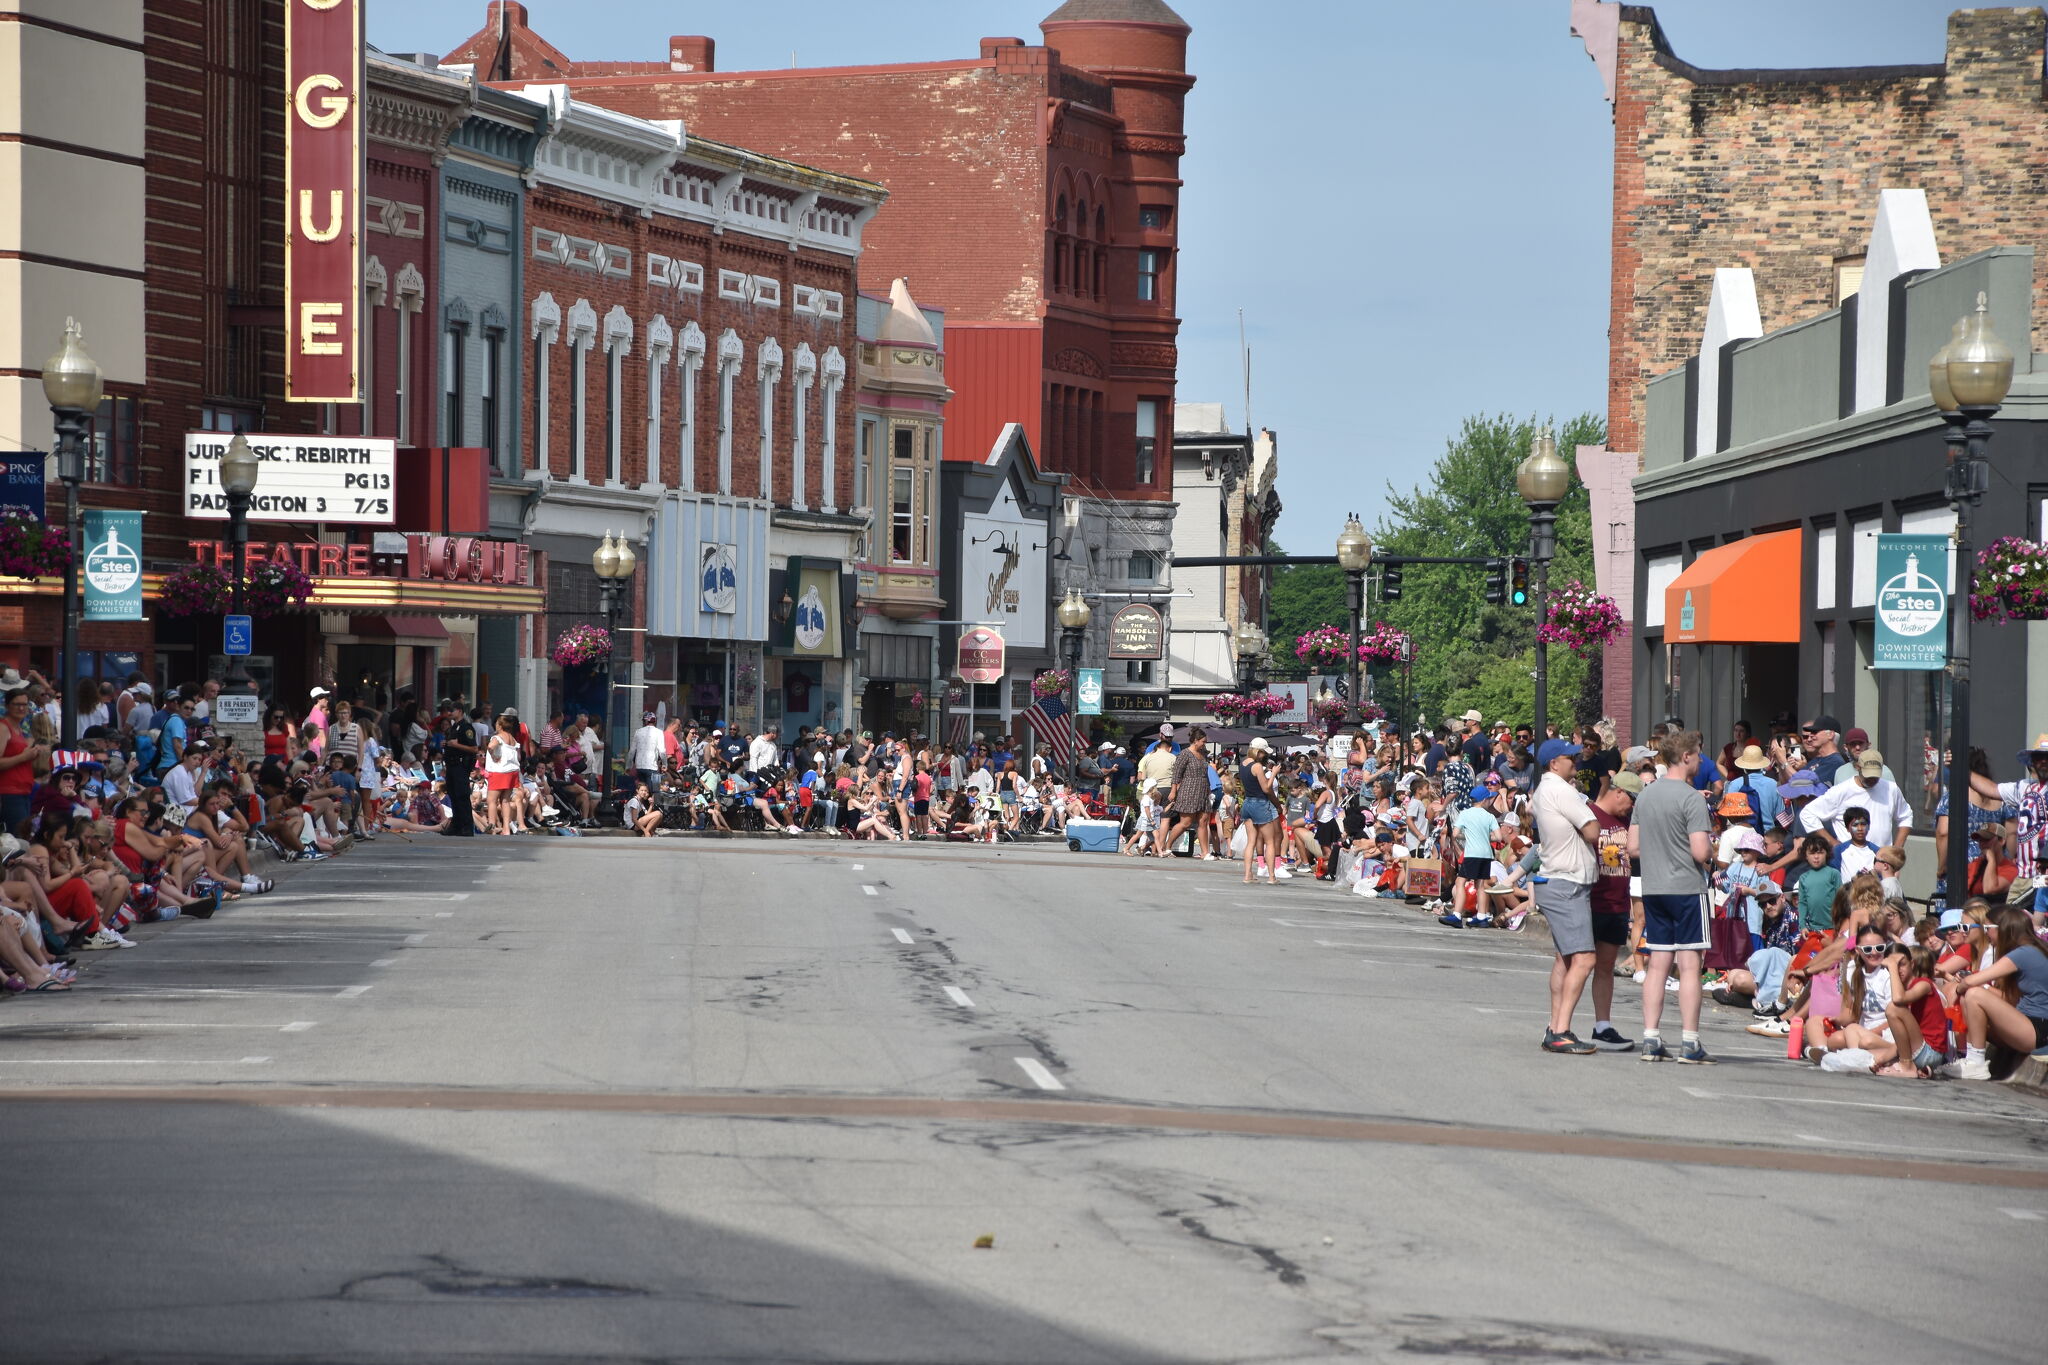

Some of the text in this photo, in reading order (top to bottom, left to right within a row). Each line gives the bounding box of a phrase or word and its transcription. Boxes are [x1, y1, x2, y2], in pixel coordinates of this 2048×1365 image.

[294, 0, 349, 356] GUE
[188, 443, 371, 464] JURSIC: REBIRTH
[9, 463, 36, 474] PNC
[8, 474, 42, 484] BANK
[344, 472, 391, 490] PG13
[190, 493, 389, 515] PADNGTON 3 7/5
[406, 534, 530, 587] VOGUE
[101, 560, 132, 572] stee
[1885, 592, 1900, 600] The
[1897, 596, 1935, 610] stee
[1888, 613, 1911, 622] Social
[1900, 624, 1927, 632] District
[1878, 644, 1943, 652] DOWNTOWN
[973, 650, 988, 659] CC
[1883, 653, 1935, 661] MANISTEE
[1136, 696, 1154, 706] Pub
